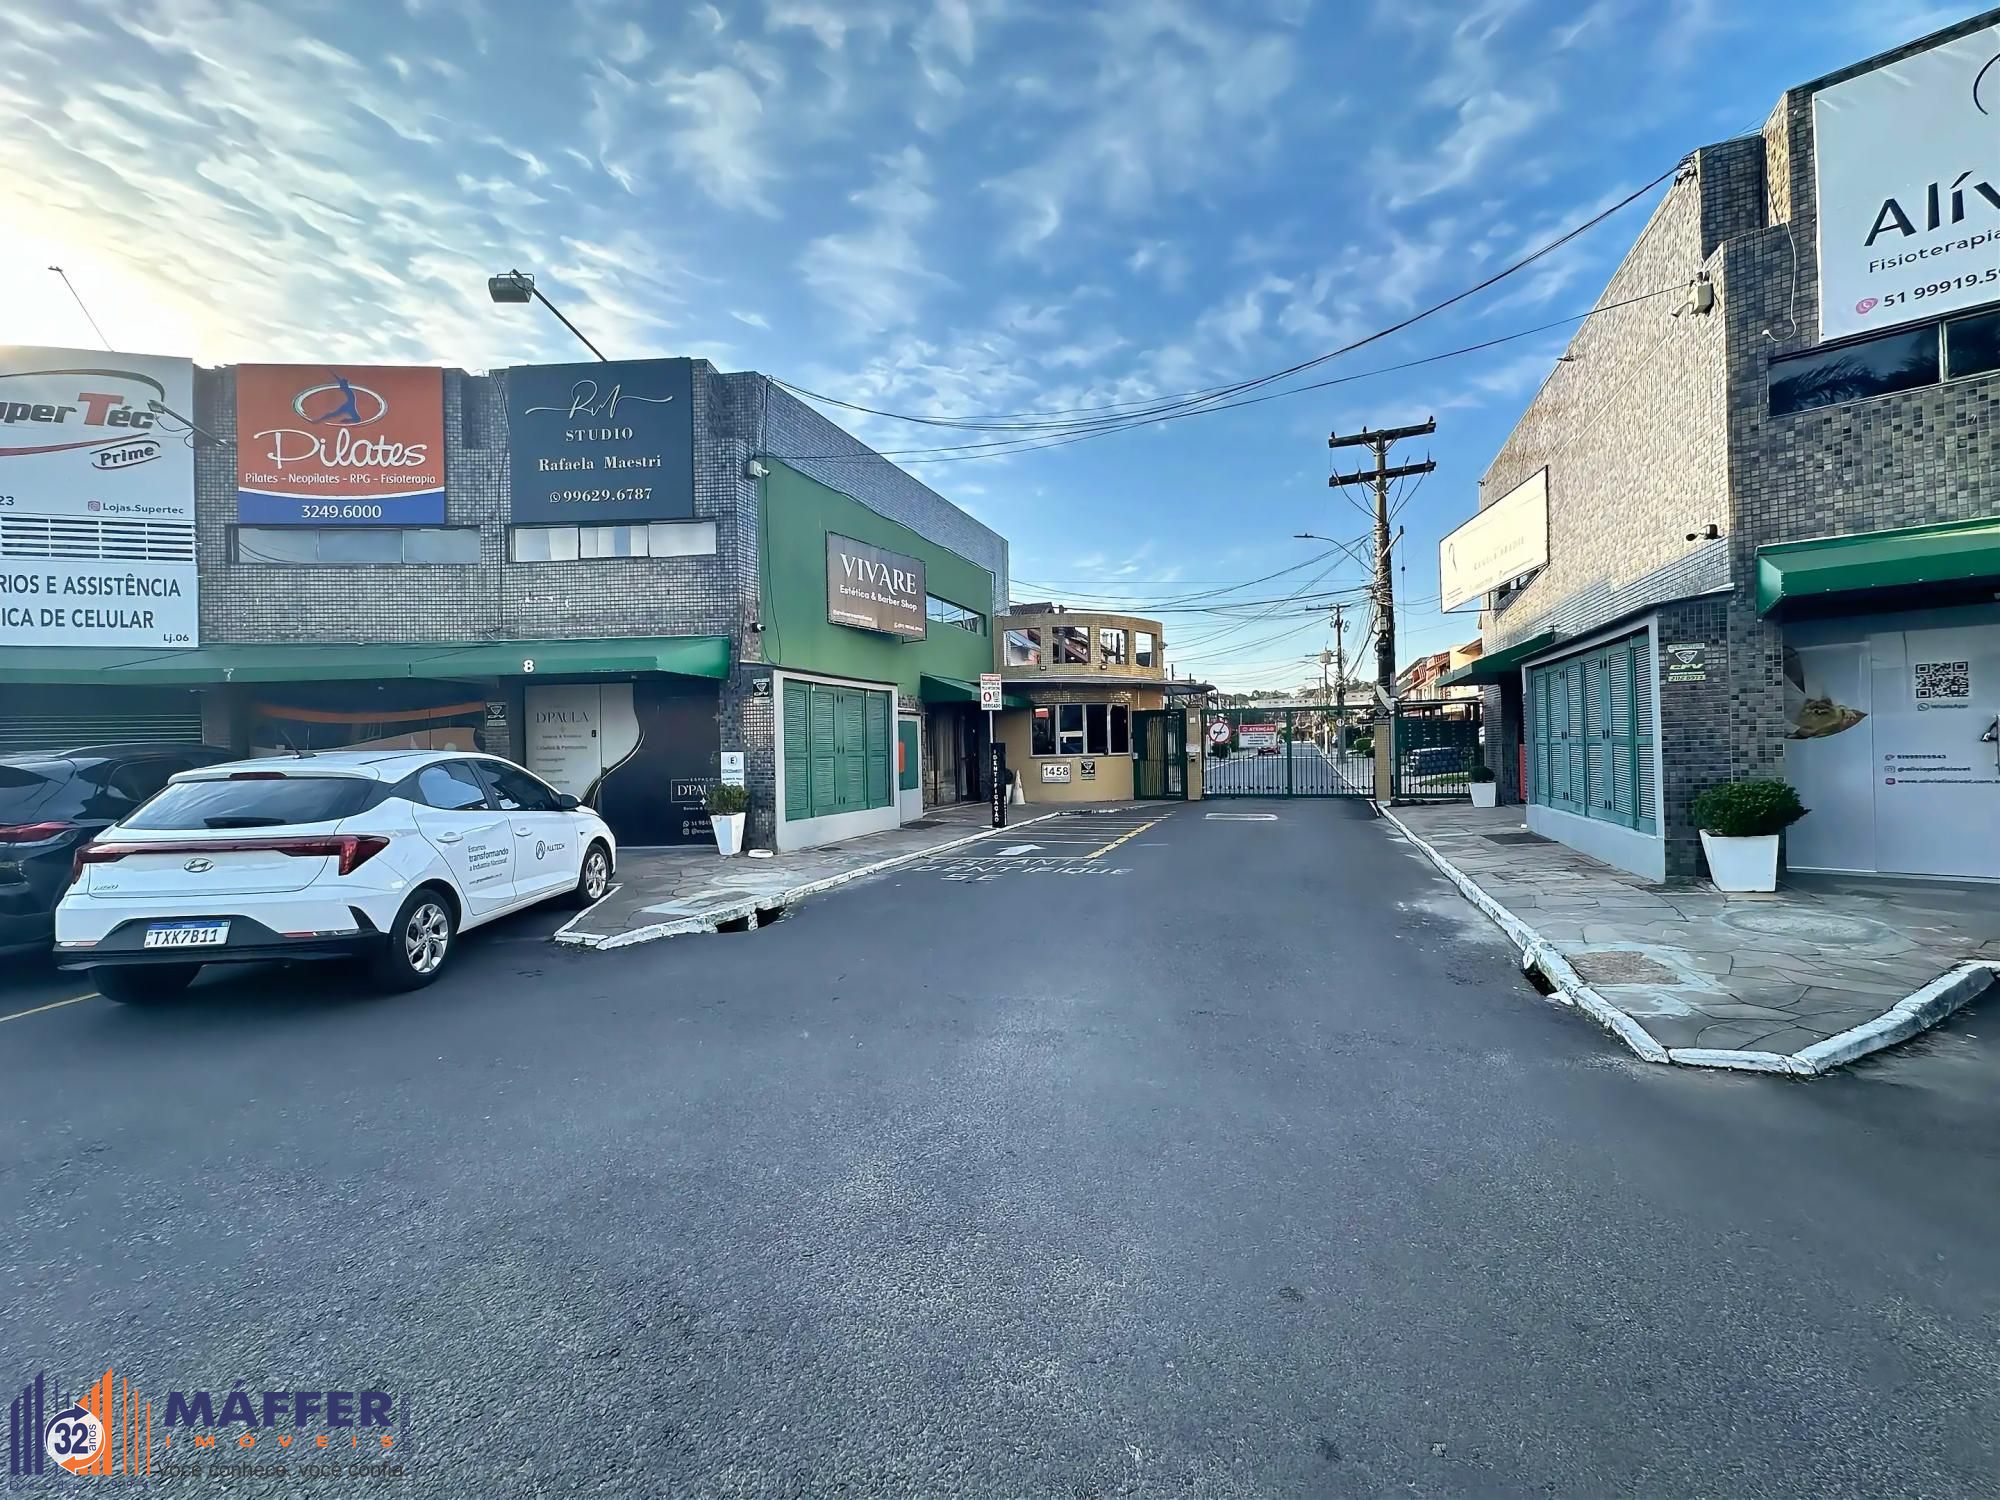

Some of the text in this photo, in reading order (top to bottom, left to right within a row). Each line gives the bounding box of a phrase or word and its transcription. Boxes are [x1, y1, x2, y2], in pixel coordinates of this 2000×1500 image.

[1884, 290, 1905, 307] 51
[565, 427, 634, 442] STUDIO
[100, 444, 155, 467] Prime
[253, 427, 428, 470] Pilates
[538, 454, 662, 473] Rafaela Maestri
[245, 473, 436, 486] Pilates Neopilates RPG Fisioterapia
[563, 487, 653, 502] 99629.6787
[103, 502, 184, 515] Lojas.Supertec
[301, 505, 382, 519] 3249.6000
[840, 552, 917, 596] VIVARE
[46, 575, 57, 594] E
[63, 573, 181, 598] ASSISTÊNCIA
[840, 584, 918, 613] Estética & Barber Shop
[41, 608, 66, 628] DE
[72, 609, 154, 629] CELULAR
[163, 632, 190, 644] Lj.06
[522, 658, 535, 673] 8
[223, 667, 234, 682] 7
[1044, 766, 1069, 777] 1458
[468, 847, 509, 863] transformando
[940, 873, 1003, 882] SE
[153, 928, 219, 946] TXK7B11
